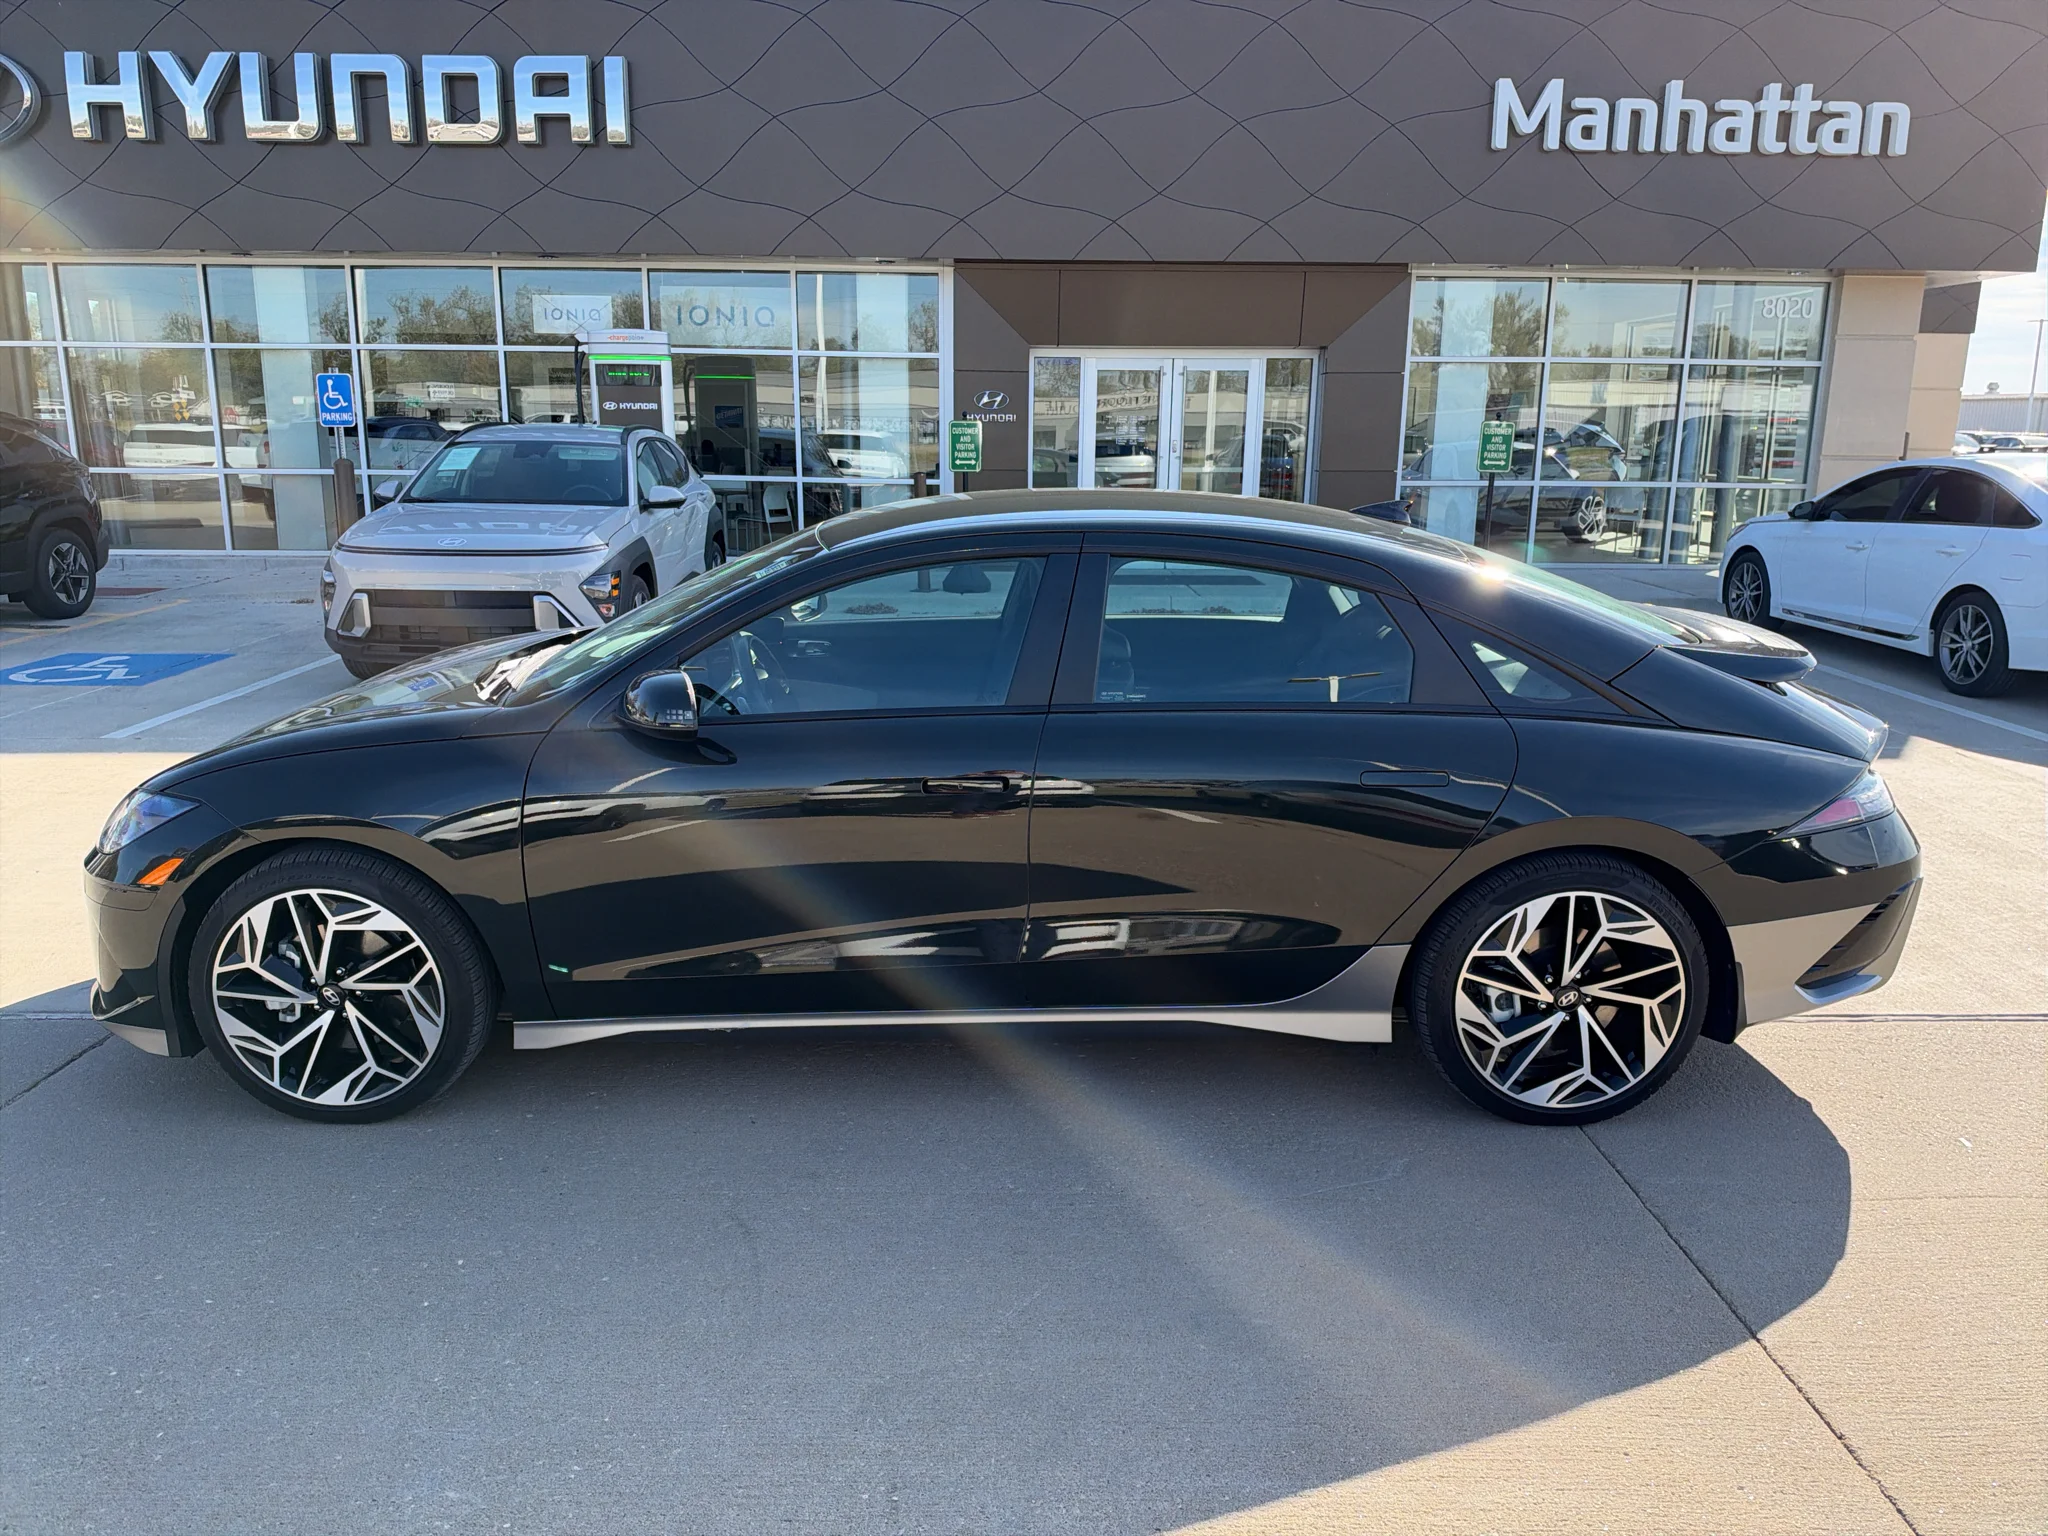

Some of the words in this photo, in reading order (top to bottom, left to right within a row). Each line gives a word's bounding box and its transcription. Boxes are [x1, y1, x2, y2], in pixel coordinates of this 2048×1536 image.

[64, 51, 631, 145] HYUNDAI
[1491, 78, 1911, 156] Manhattan
[544, 308, 601, 321] IONIQ
[1762, 297, 1813, 319] 8020
[677, 305, 775, 327] IONIQ
[619, 402, 658, 410] HYUNDAI
[321, 412, 353, 421] PARKING
[966, 413, 1017, 423] HYUNDAI
[1483, 451, 1507, 459] PARKING
